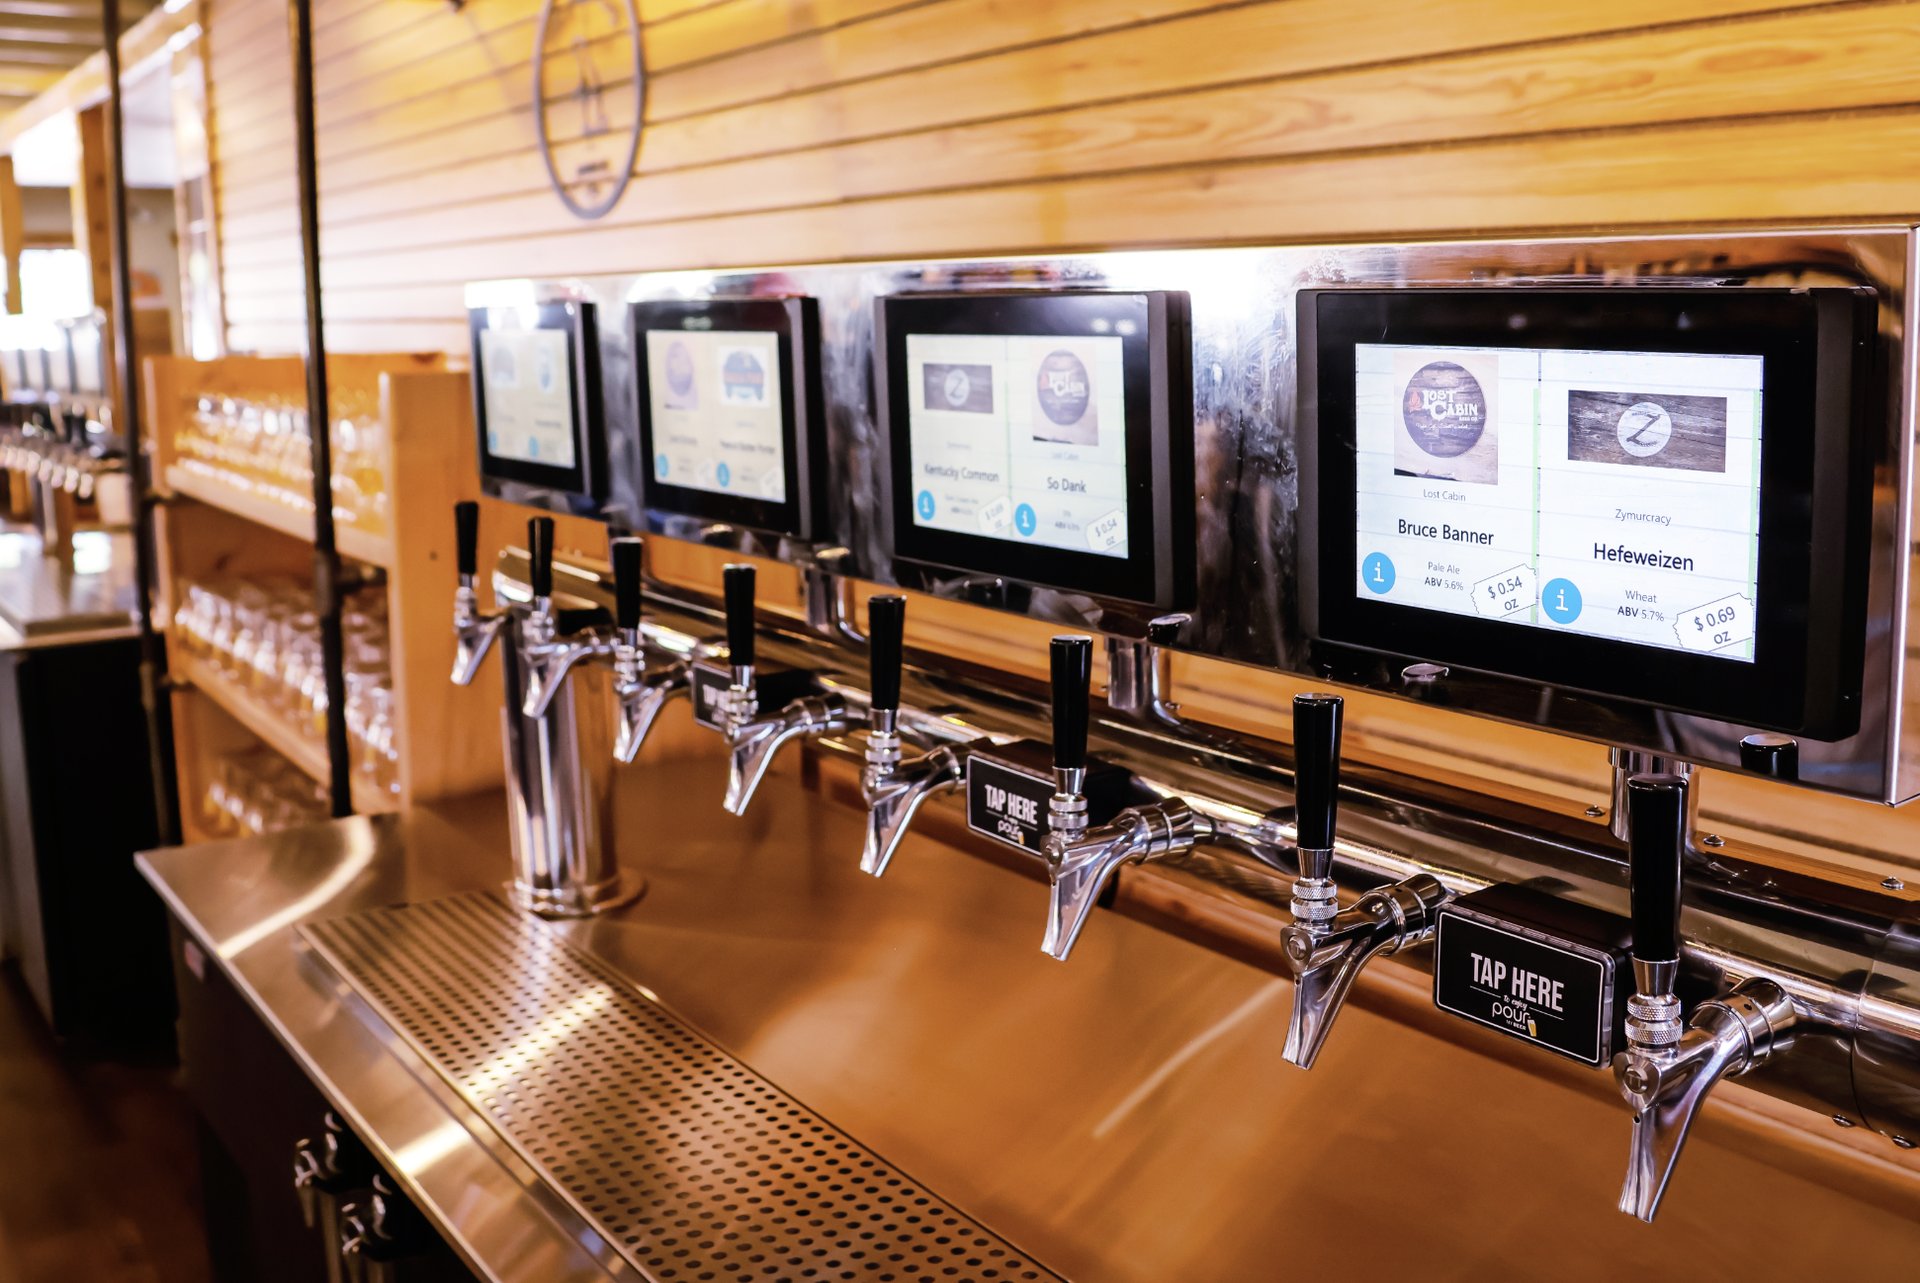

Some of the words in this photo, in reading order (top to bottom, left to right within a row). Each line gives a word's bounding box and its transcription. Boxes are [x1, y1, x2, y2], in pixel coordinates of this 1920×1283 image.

[1422, 389, 1457, 410] LOST
[1430, 400, 1478, 421] CABIN
[961, 466, 1000, 483] Common
[1047, 476, 1059, 490] So
[1062, 477, 1087, 493] Dank
[1423, 489, 1440, 499] Lost
[1442, 490, 1466, 501] Cabin
[1615, 508, 1672, 527] Zymurcracy
[1398, 518, 1438, 539] Bruce
[1442, 524, 1495, 546] Banner
[1594, 542, 1694, 571] Hefeweizen
[1428, 561, 1445, 573] Pale
[1447, 564, 1460, 575] Ale
[1424, 576, 1442, 588] ABV
[1444, 579, 1464, 591] 5.6%
[1487, 585, 1497, 600] $
[1497, 575, 1523, 596] 0.54
[1625, 589, 1657, 604] Wheat
[1617, 605, 1639, 618] ABV
[1641, 609, 1665, 622] 5.7%
[1694, 616, 1705, 633] $
[1705, 606, 1736, 627] 0.69
[984, 783, 1006, 812] TAP
[1007, 792, 1038, 825] HERE
[1470, 952, 1507, 990] TAP
[1511, 966, 1565, 1013] HERE
[1491, 1001, 1530, 1025] pour
